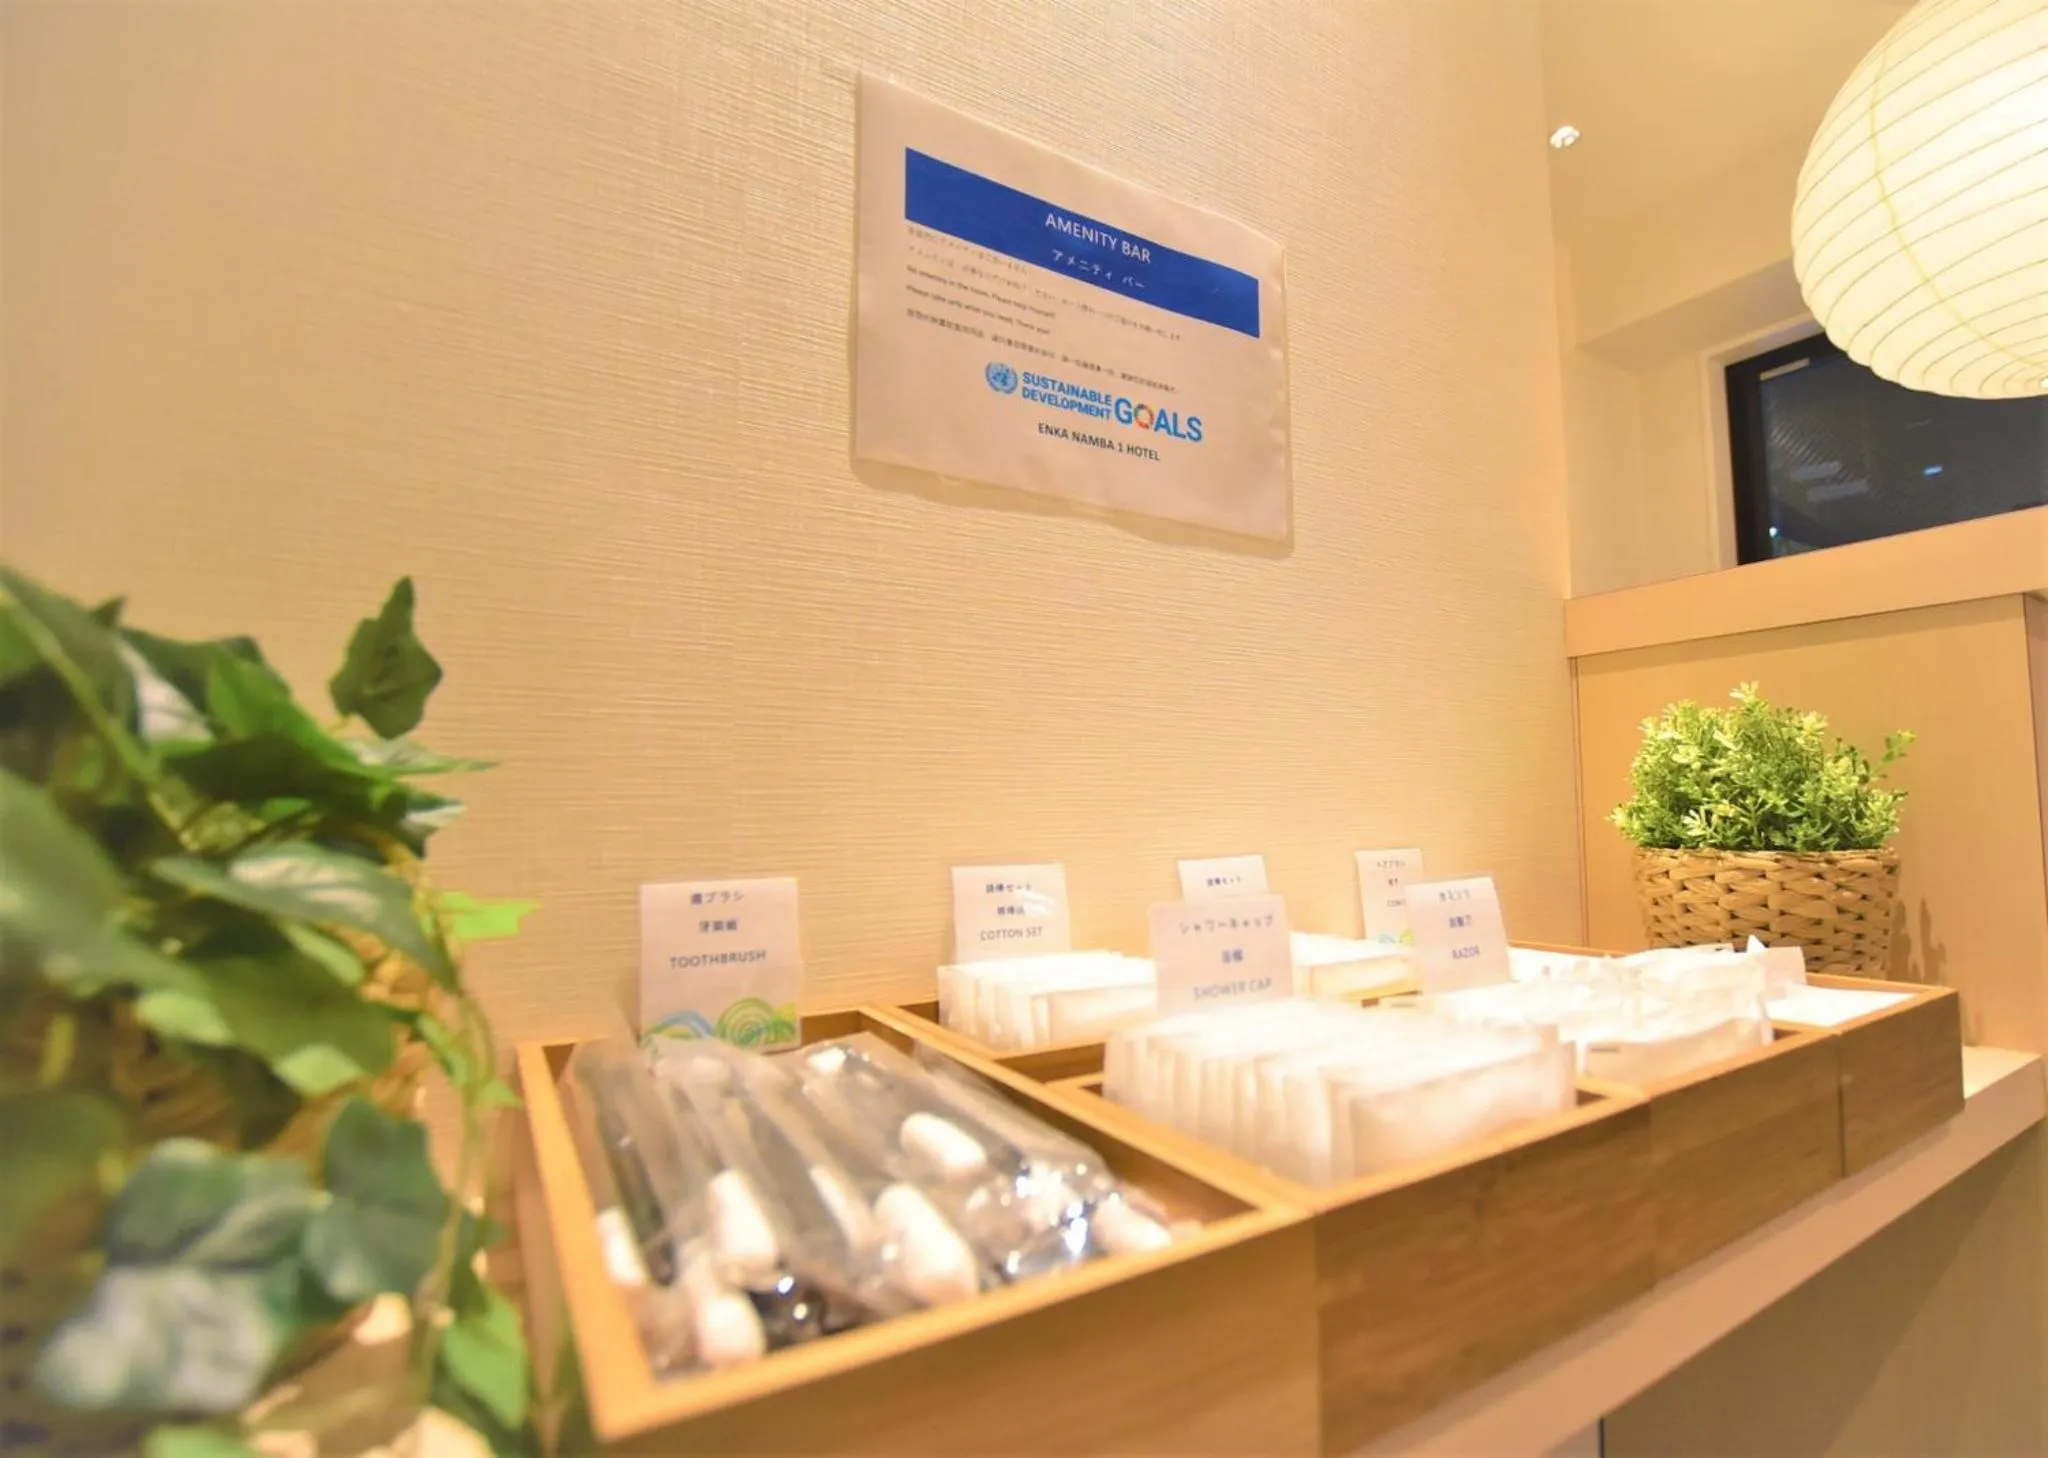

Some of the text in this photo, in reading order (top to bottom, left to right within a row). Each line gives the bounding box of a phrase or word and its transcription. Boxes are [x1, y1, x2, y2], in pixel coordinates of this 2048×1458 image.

[1045, 212, 1151, 264] AMENITY BAR
[1052, 249, 1113, 281] アメニティ
[1122, 275, 1146, 289] バー
[1021, 388, 1111, 421] DEVELOPMENT
[1022, 371, 1112, 406] SUSTAINABLE
[1114, 397, 1203, 442] GOALS
[1038, 422, 1160, 461] ENKA NAMBA 1 HOTEL
[980, 926, 1043, 941] COTTON SET
[669, 950, 766, 969] TOOTHBRUSH
[1452, 945, 1481, 960] RAZOR
[1193, 977, 1272, 1000] SHOWER CAP
